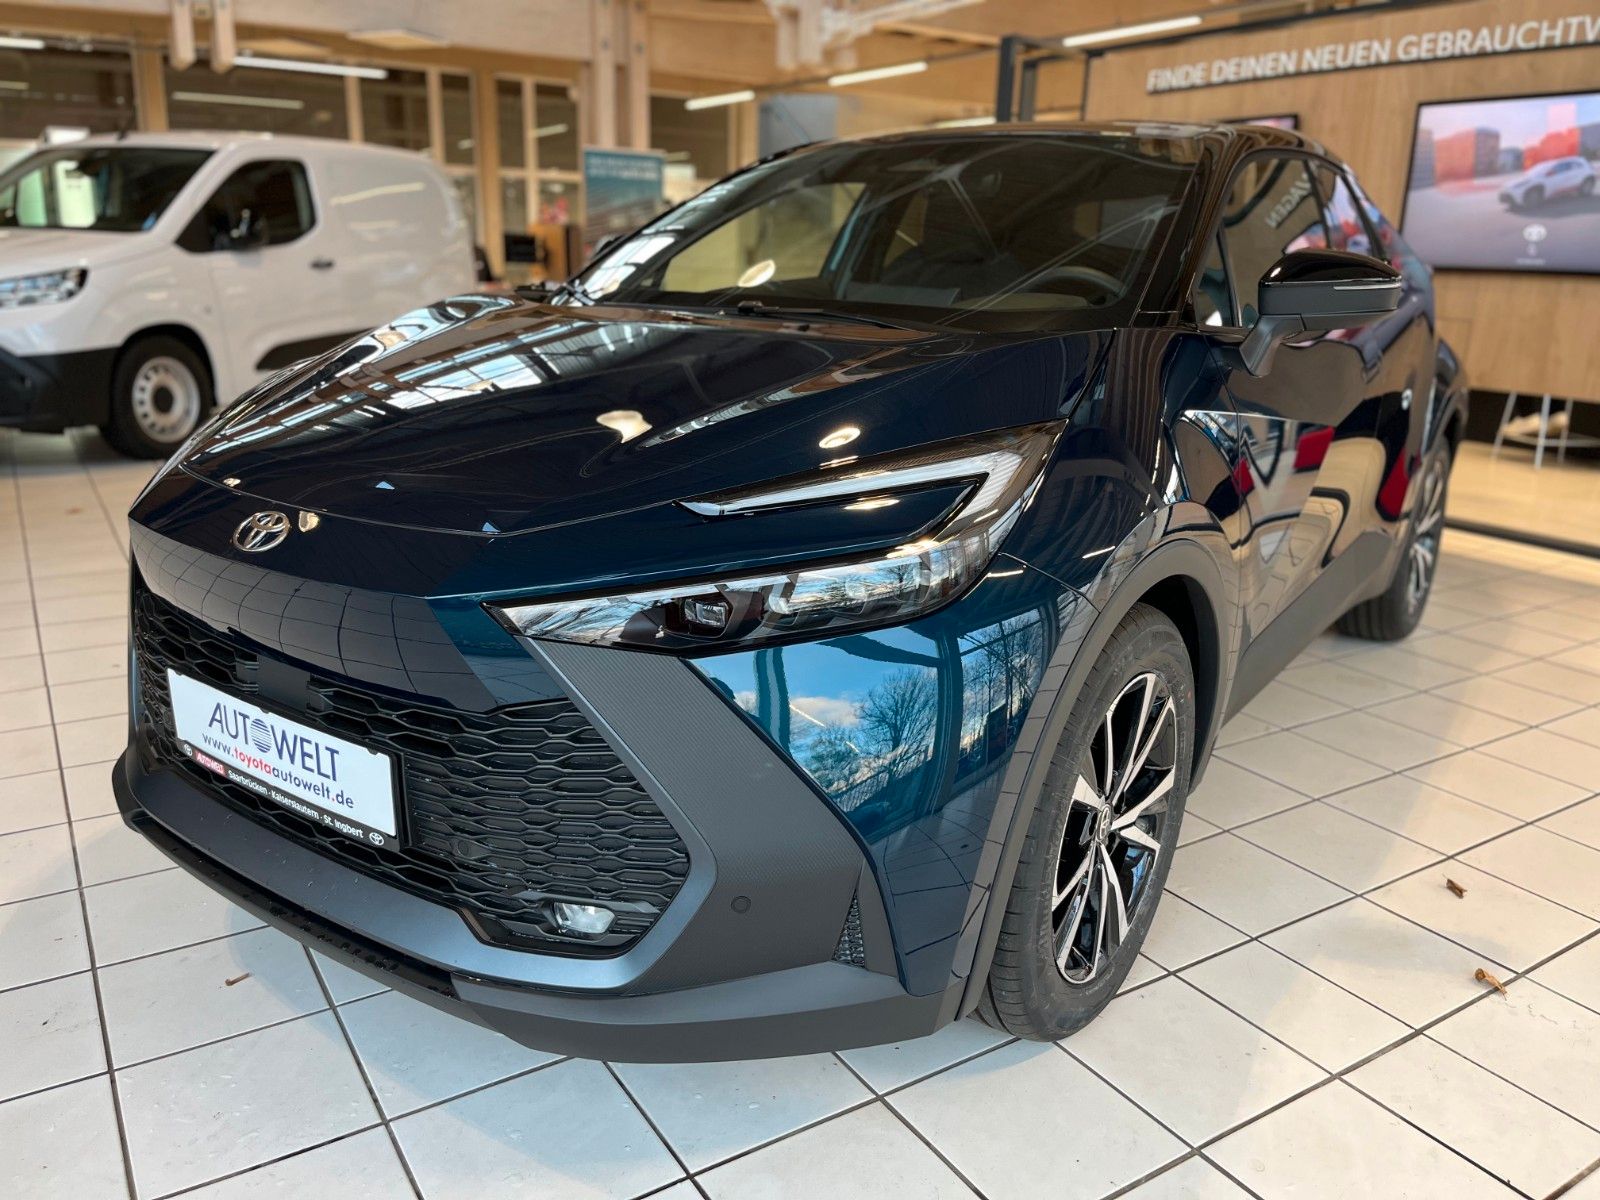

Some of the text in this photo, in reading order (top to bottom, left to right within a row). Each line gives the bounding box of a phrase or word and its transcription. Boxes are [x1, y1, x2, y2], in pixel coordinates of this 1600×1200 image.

[1147, 61, 1207, 94] FINDE
[1211, 49, 1299, 85] DEINEN
[1301, 38, 1391, 72] NEUEN
[202, 732, 355, 809] www.toyotaautowelt.de
[208, 702, 339, 782] AUTOWELT
[228, 769, 268, 796] Saarbrücken
[271, 790, 319, 820] Kaiserslautern
[323, 814, 334, 826] St.
[335, 819, 364, 839] Ingbert
